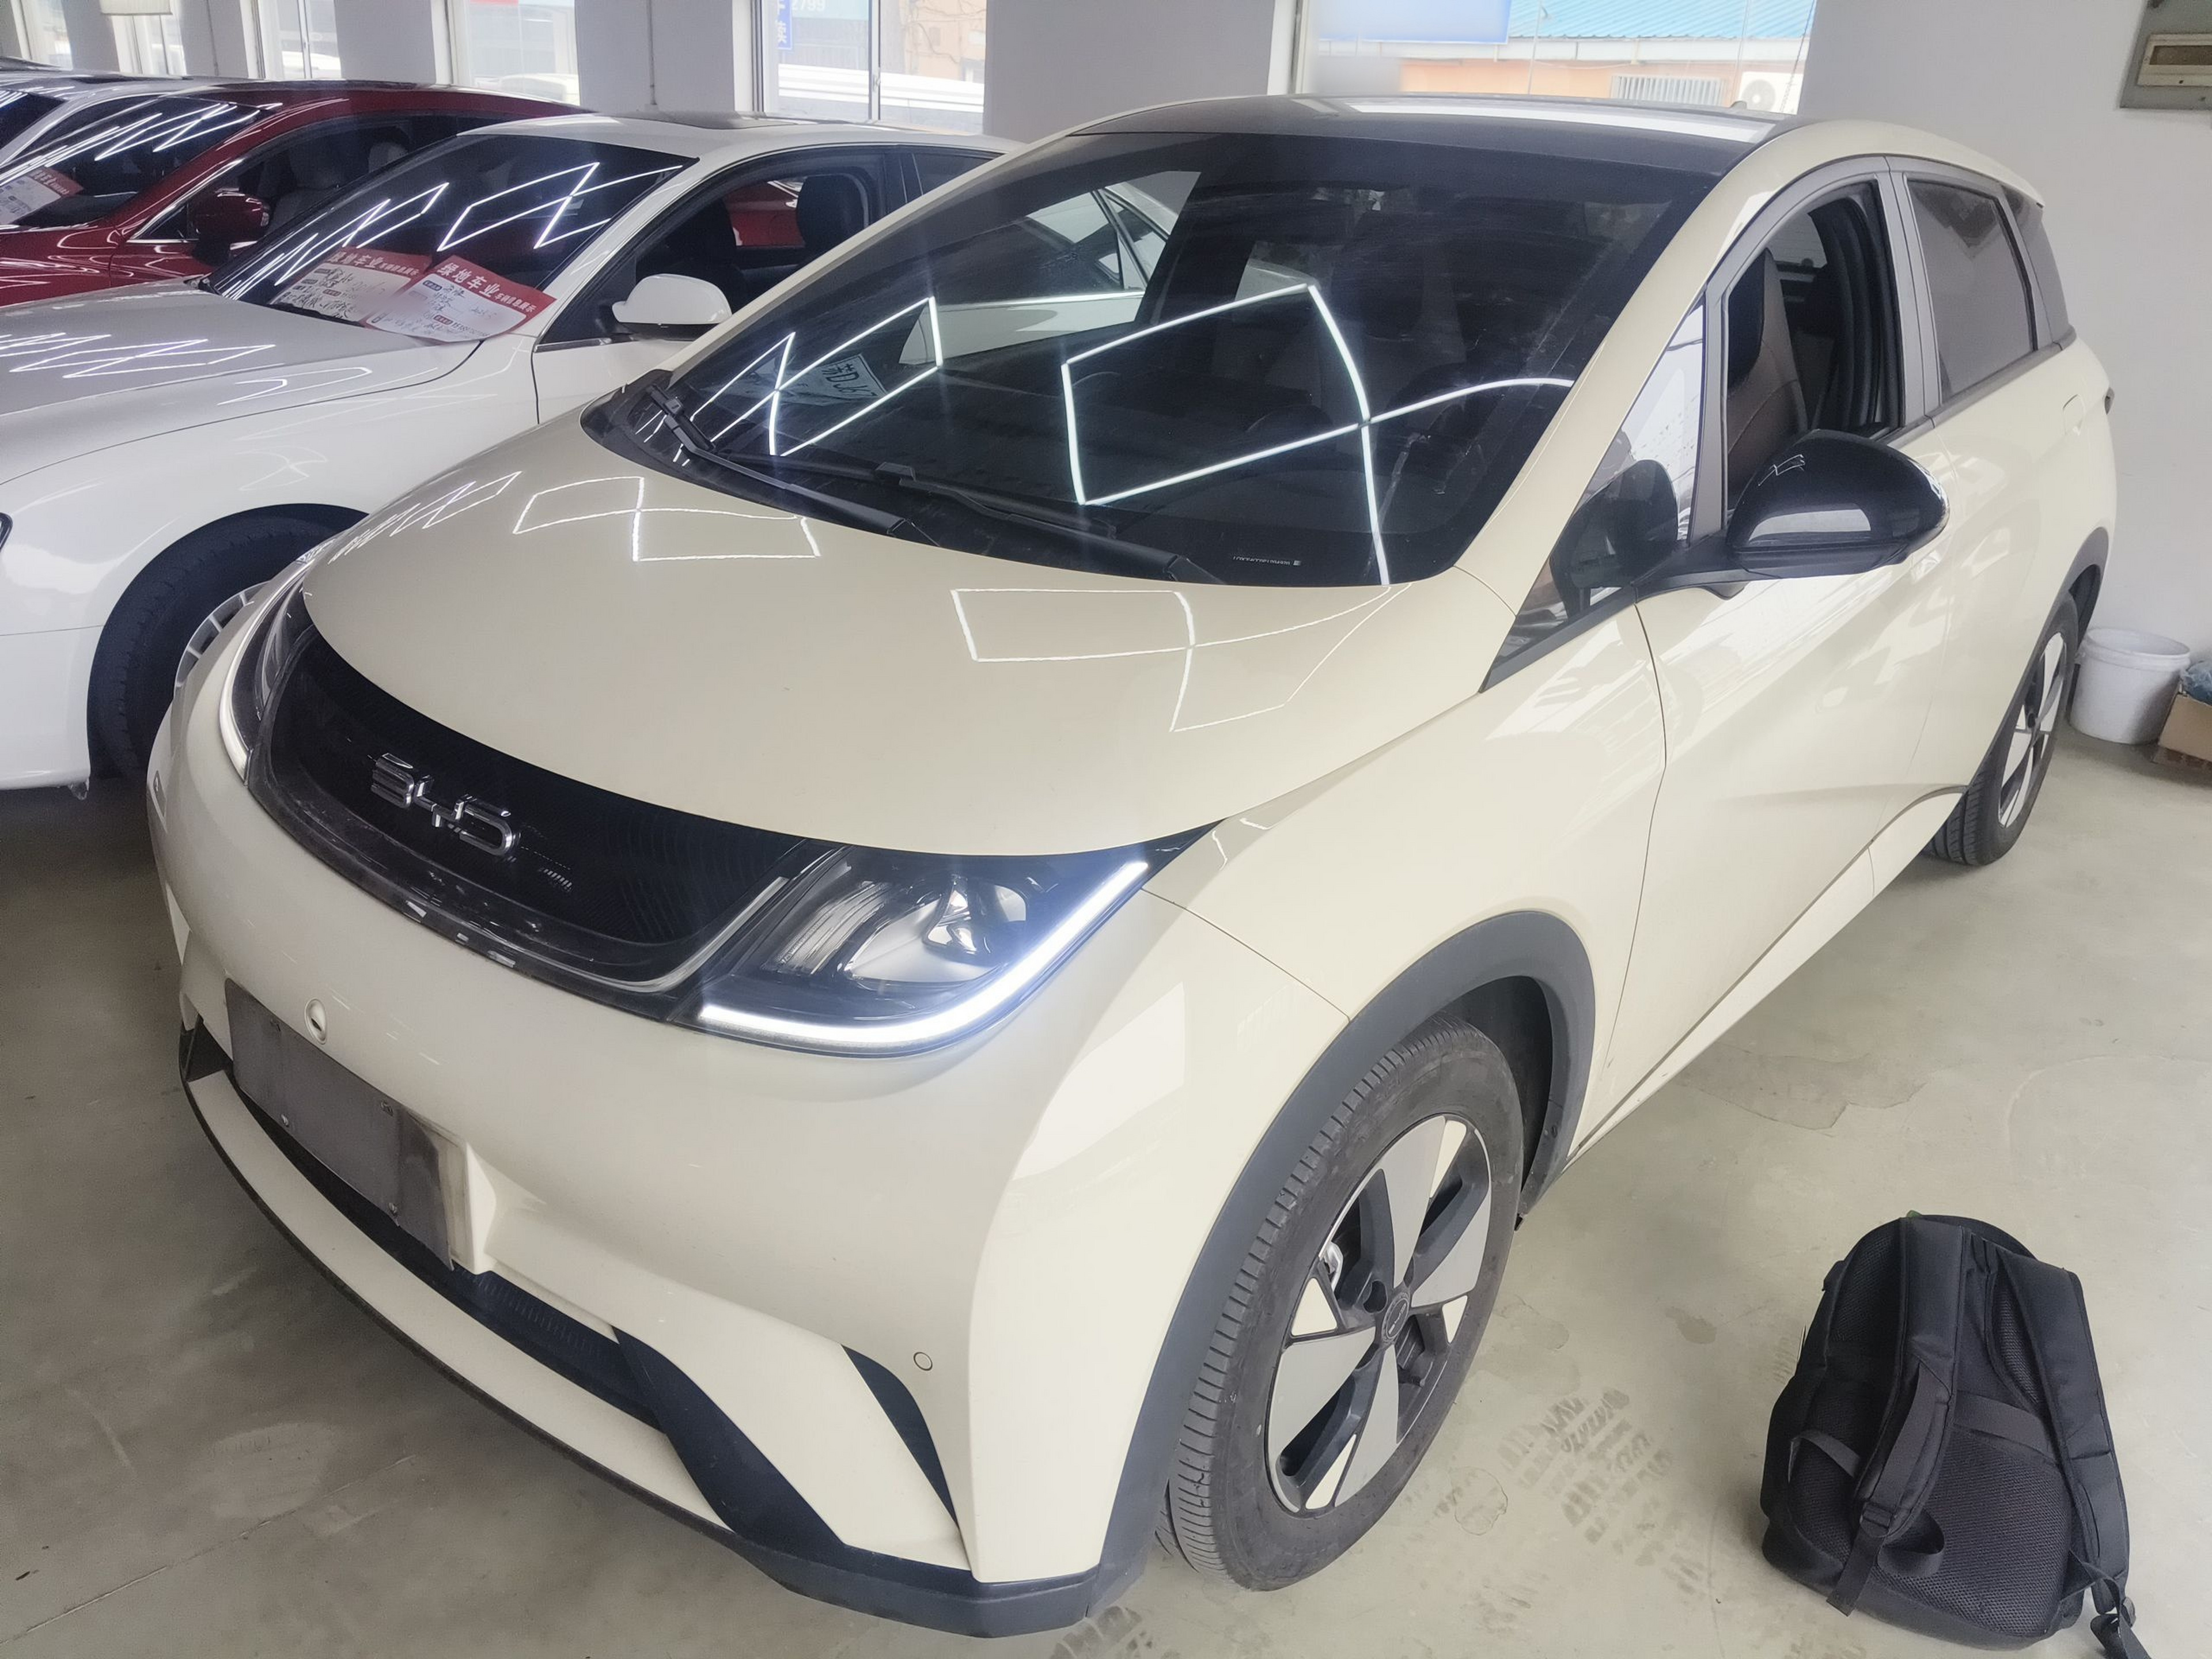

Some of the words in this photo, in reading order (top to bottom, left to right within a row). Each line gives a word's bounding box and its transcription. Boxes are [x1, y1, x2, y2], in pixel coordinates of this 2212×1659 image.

[437, 263, 501, 297] 绿地车业
[370, 753, 513, 857] BYD
